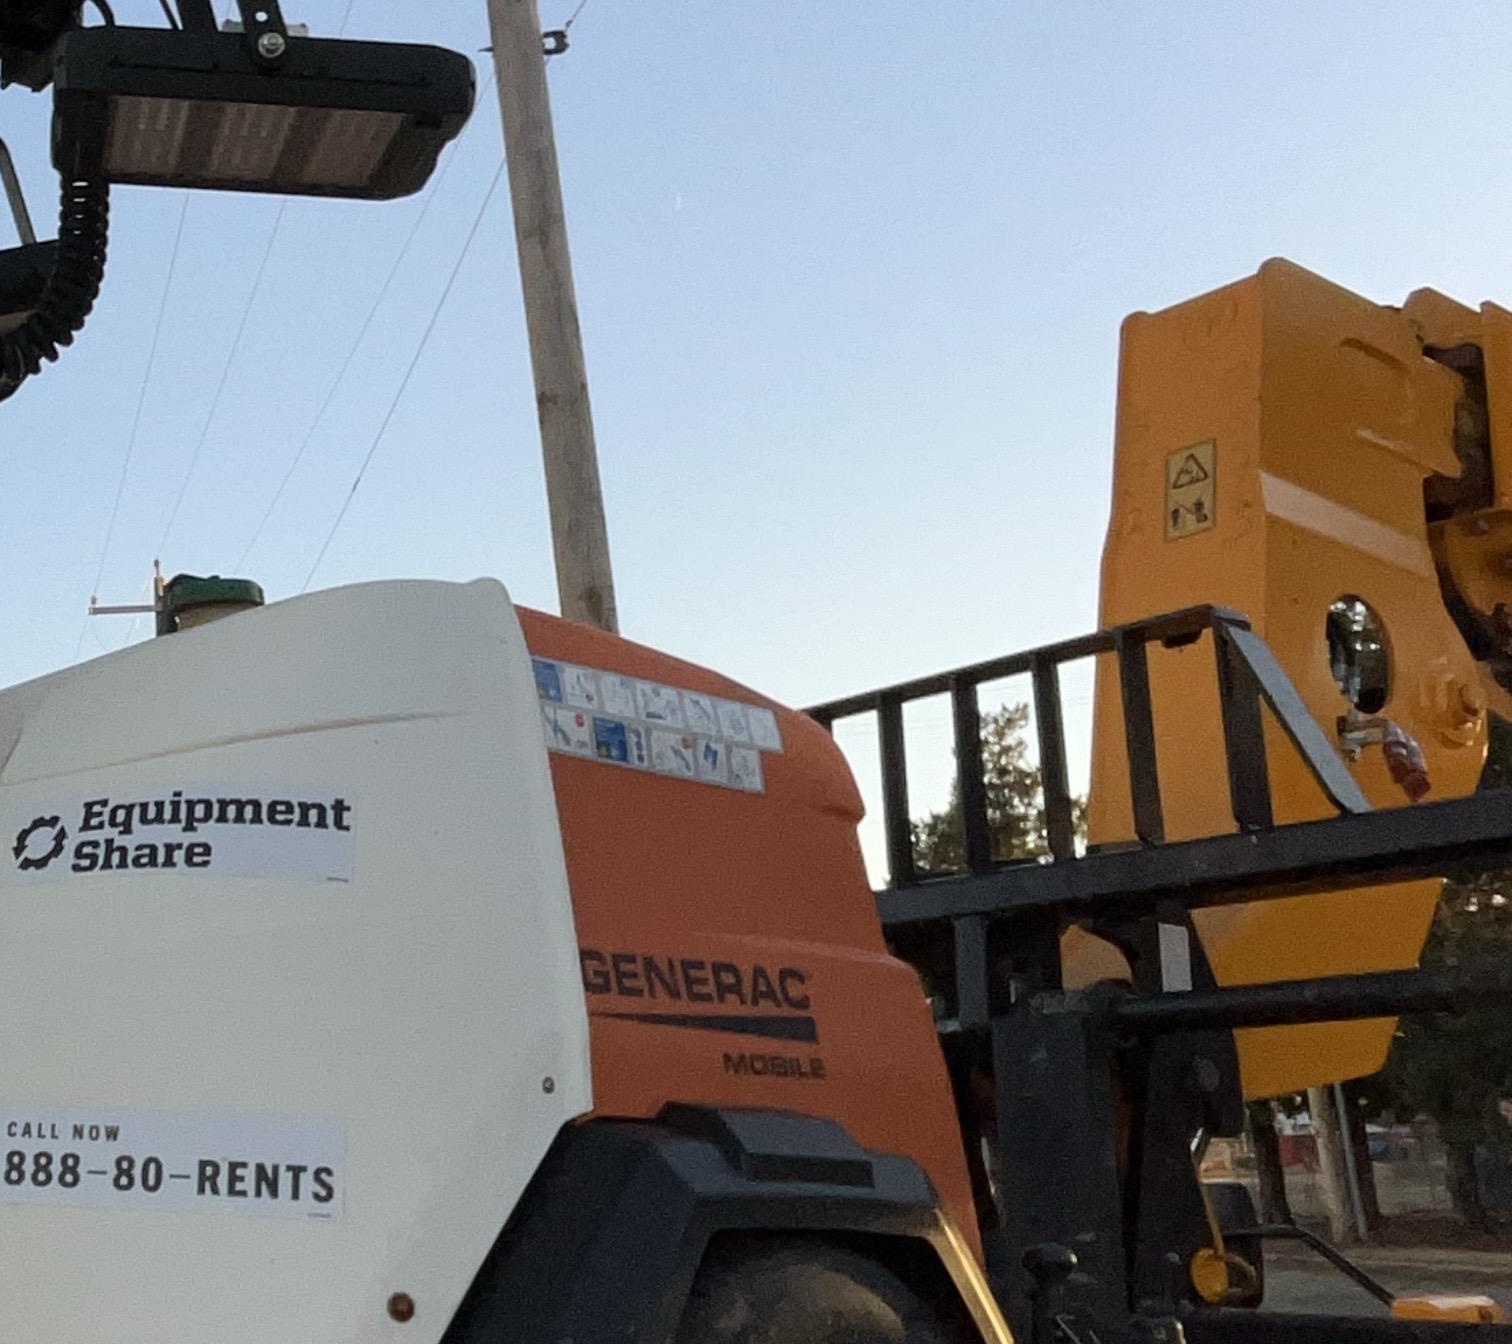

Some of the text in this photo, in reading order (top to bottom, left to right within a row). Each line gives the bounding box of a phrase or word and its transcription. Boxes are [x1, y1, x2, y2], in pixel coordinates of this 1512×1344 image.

[78, 790, 352, 836] Equipment
[70, 836, 213, 873] Share
[580, 949, 811, 1010] GENERAC
[722, 1052, 827, 1080] MOBILE
[6, 1121, 120, 1142] CALL NOW
[3, 1150, 335, 1204] 888-80-RENTS
